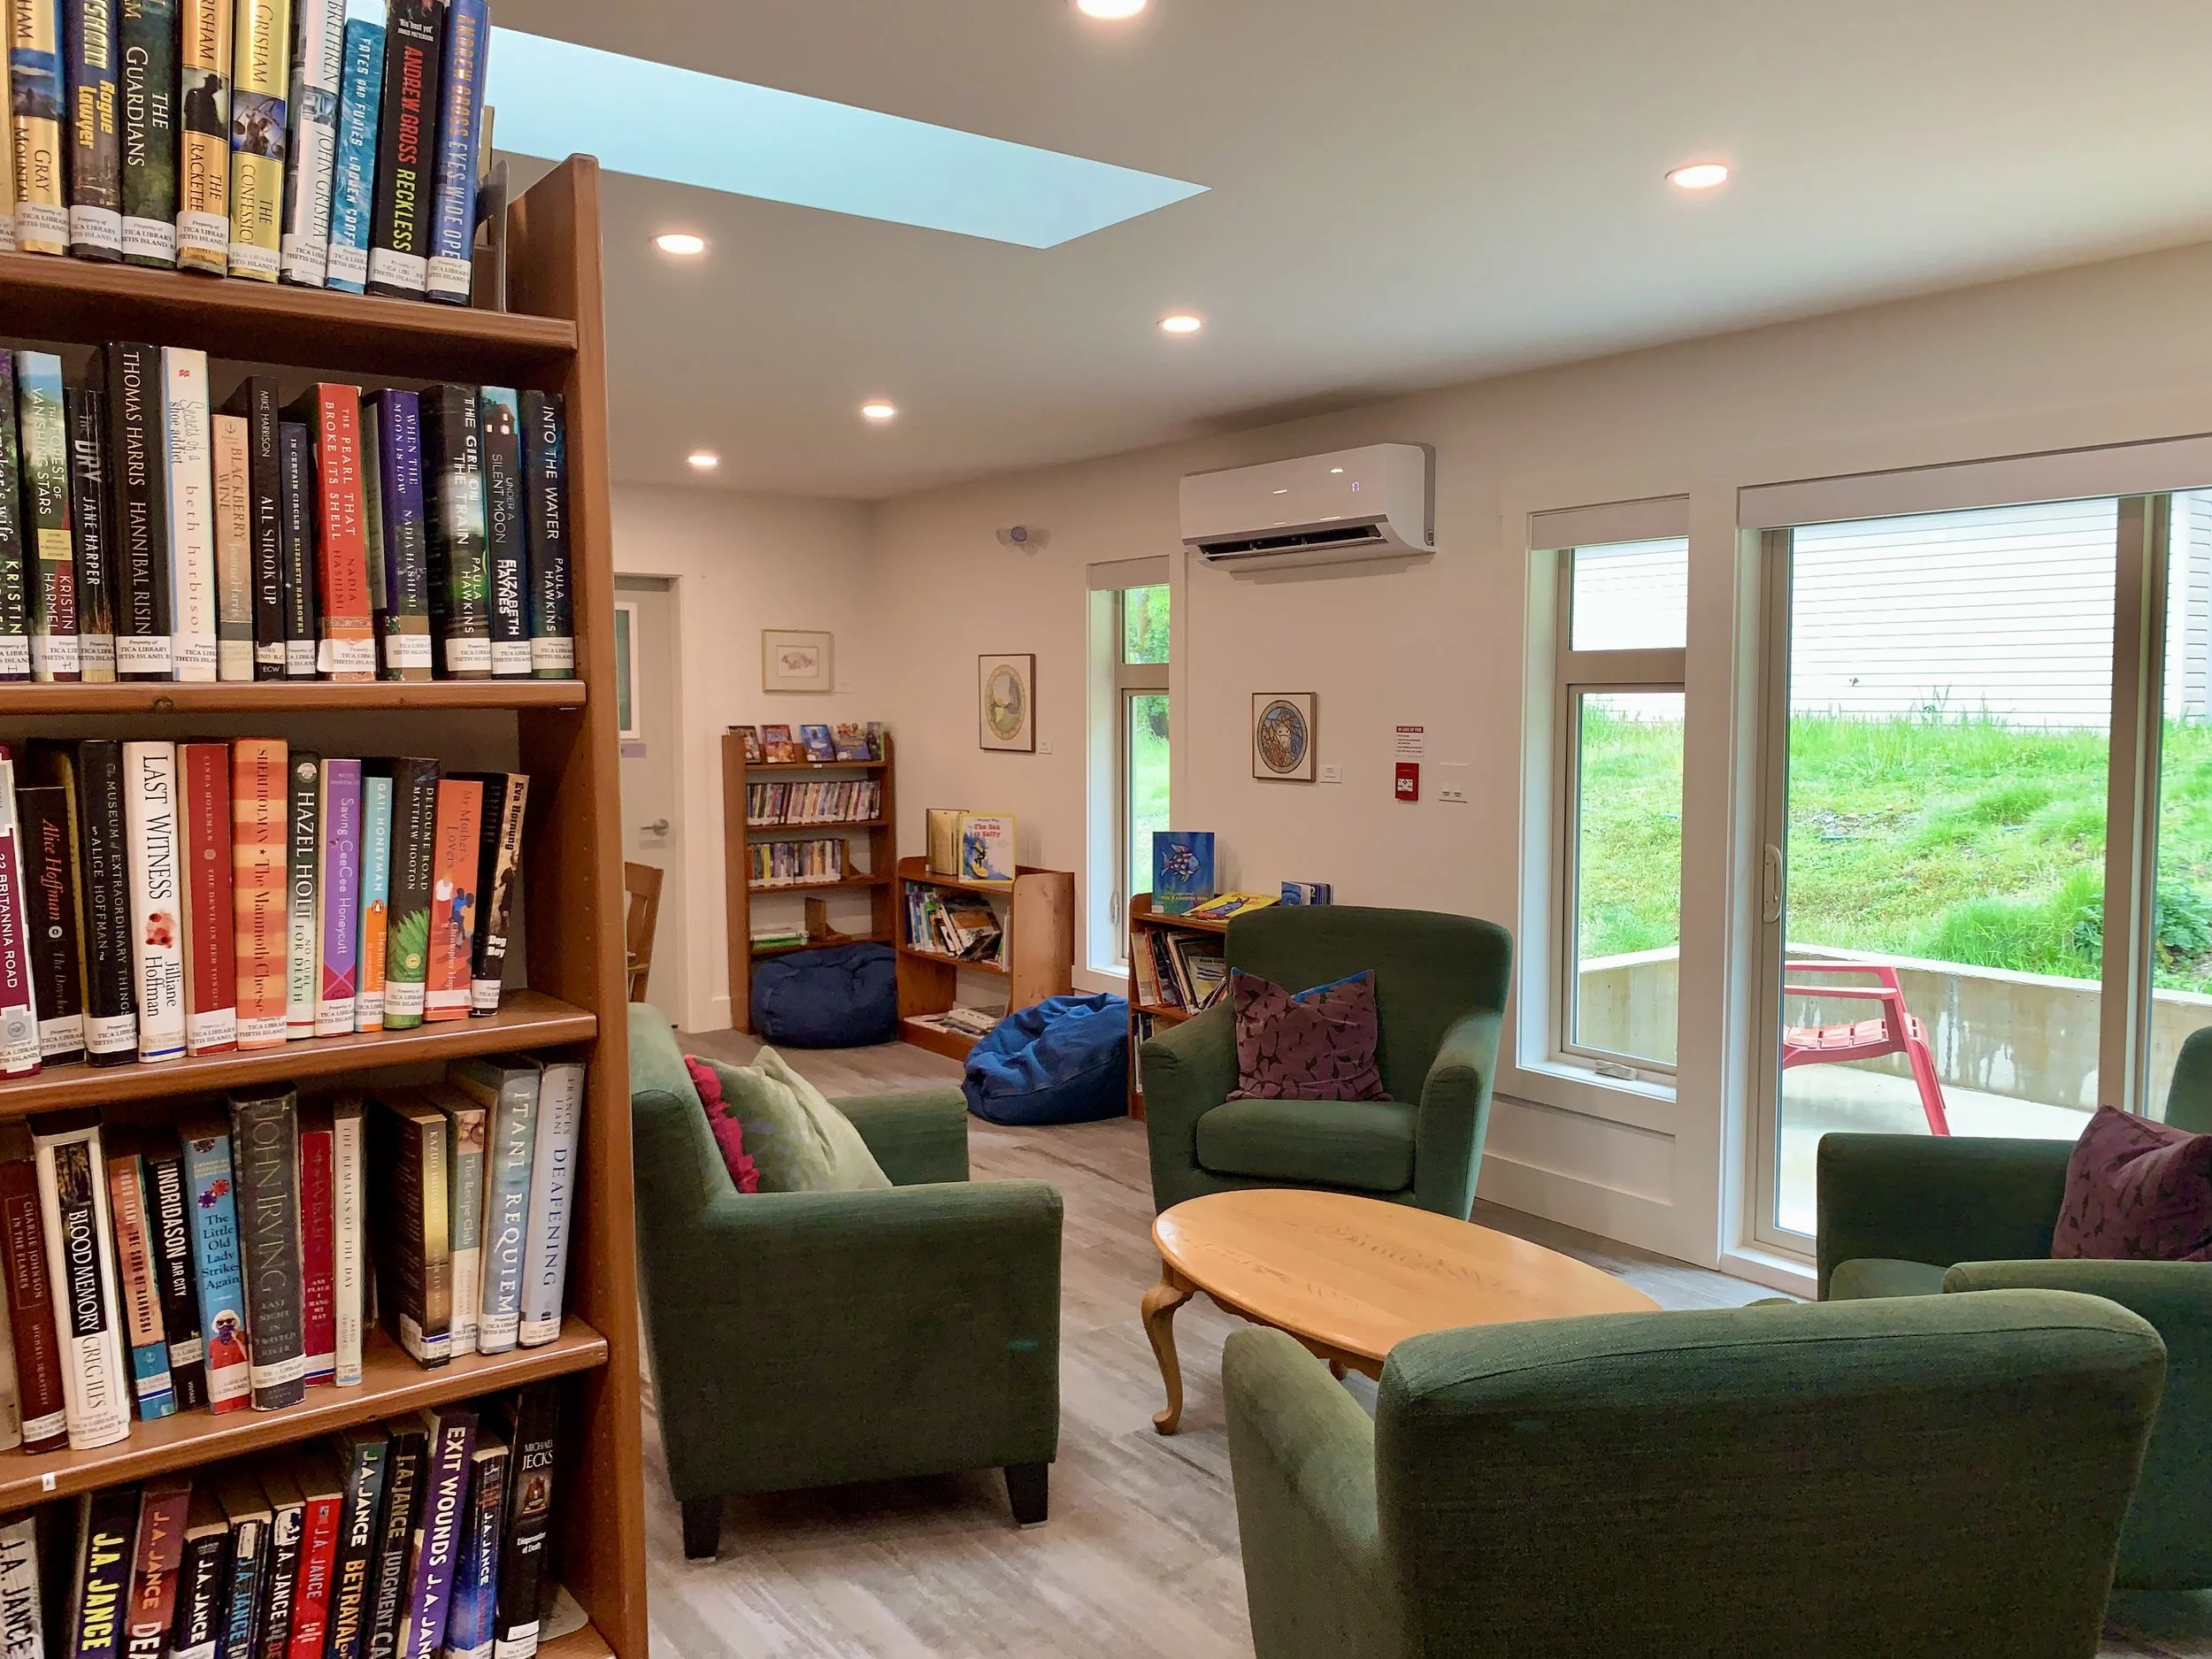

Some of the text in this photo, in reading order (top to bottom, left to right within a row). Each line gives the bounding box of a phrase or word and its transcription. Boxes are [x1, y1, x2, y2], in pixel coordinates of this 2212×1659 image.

[252, 4, 273, 84] GRISHAM
[356, 37, 372, 76] FATES
[76, 85, 97, 150] Lawyer
[99, 79, 116, 134] Rogue
[126, 45, 149, 168] GUARDIANS
[151, 92, 169, 130] THE
[443, 13, 476, 226] ANDREW GROSS EYES WIDE
[34, 148, 52, 193] GRAY
[393, 44, 424, 253] ANDREW GROSS RECKLESS
[209, 173, 223, 202] THE
[258, 198, 273, 226] THE
[30, 387, 52, 516] VANISHING STARS
[259, 389, 271, 458] MIKE HARRISON
[394, 403, 407, 495] MOON IS LOW
[405, 414, 419, 486] WHEN THE
[463, 396, 480, 502] THE GIRL ON
[52, 486, 62, 500] OF
[73, 439, 104, 484] DRY
[122, 351, 150, 587] THOMAS HARRIS HANNIBAL
[219, 472, 231, 511] WINE
[230, 447, 247, 541] BLACKBERRY
[289, 438, 301, 531] IN CERTAIN CIRCLES
[325, 401, 342, 541] BROKE ITS SHELL
[341, 408, 356, 536] THE PEARL THAT
[504, 477, 516, 511] UNDER
[541, 404, 560, 541] INTO THE WATER
[185, 486, 201, 531] beth
[452, 452, 470, 545] THE TRAIN
[491, 453, 507, 544] SILENT MOON
[82, 495, 101, 586] JANE HARPER
[260, 495, 278, 605] ALL SHOOK UP
[403, 509, 418, 609] NADIA HASHIMI
[5, 560, 23, 634] KRISTIN
[58, 575, 74, 630] KRISTIN
[333, 549, 344, 611] HASHIMI
[346, 557, 357, 603] NADIA
[461, 571, 475, 634] HAWKINS
[472, 557, 483, 600] PAULA
[496, 558, 511, 616] HAYNES
[506, 558, 520, 636] ELIZABETH
[543, 570, 557, 634] HAWKINS
[554, 557, 565, 600] PAULA
[142, 754, 173, 901] LAST WITNESS
[336, 796, 355, 837] Saving
[373, 782, 388, 893] GAIL HONEYMAN
[406, 786, 422, 891] MATTHEW HOOTON
[419, 787, 434, 891] DELOUME ROAD
[445, 825, 459, 870] Lovers
[458, 809, 472, 864] Mother's
[504, 780, 525, 851] Eva Hornung
[40, 817, 65, 921] Alice Hoffman
[105, 780, 128, 964] MUSEUM EXTRAORDINARY
[294, 790, 316, 920] HAZEL HOLT
[339, 840, 354, 893] CeeCee
[91, 838, 109, 949] ALICE HOFFMAN
[334, 897, 352, 956] Honeycutt
[4, 949, 19, 989] ROAD
[144, 956, 166, 1018] Hoffman
[165, 961, 182, 1008] Jilliane
[507, 1091, 531, 1170] ITANI
[157, 1167, 188, 1297] INDRIDASON JAR CITY
[203, 1225, 234, 1240] Little
[204, 1213, 229, 1226] The
[208, 1237, 231, 1252] Old
[256, 1192, 288, 1294] IRVING
[494, 1192, 524, 1313] REQUIEM
[542, 1148, 568, 1286] DEAFENING
[68, 1209, 100, 1333] BLOOD MEMORY
[205, 1275, 241, 1290] Again
[206, 1250, 234, 1265] Lady
[429, 1426, 467, 1568] EXIT WOUNDS
[81, 1532, 126, 1652] J.A. JANCE
[142, 1510, 170, 1611] J.A. JANCE
[196, 1559, 214, 1590] J.A.
[190, 1592, 211, 1645] JANCE
[334, 1558, 366, 1650] BETRAYAL
